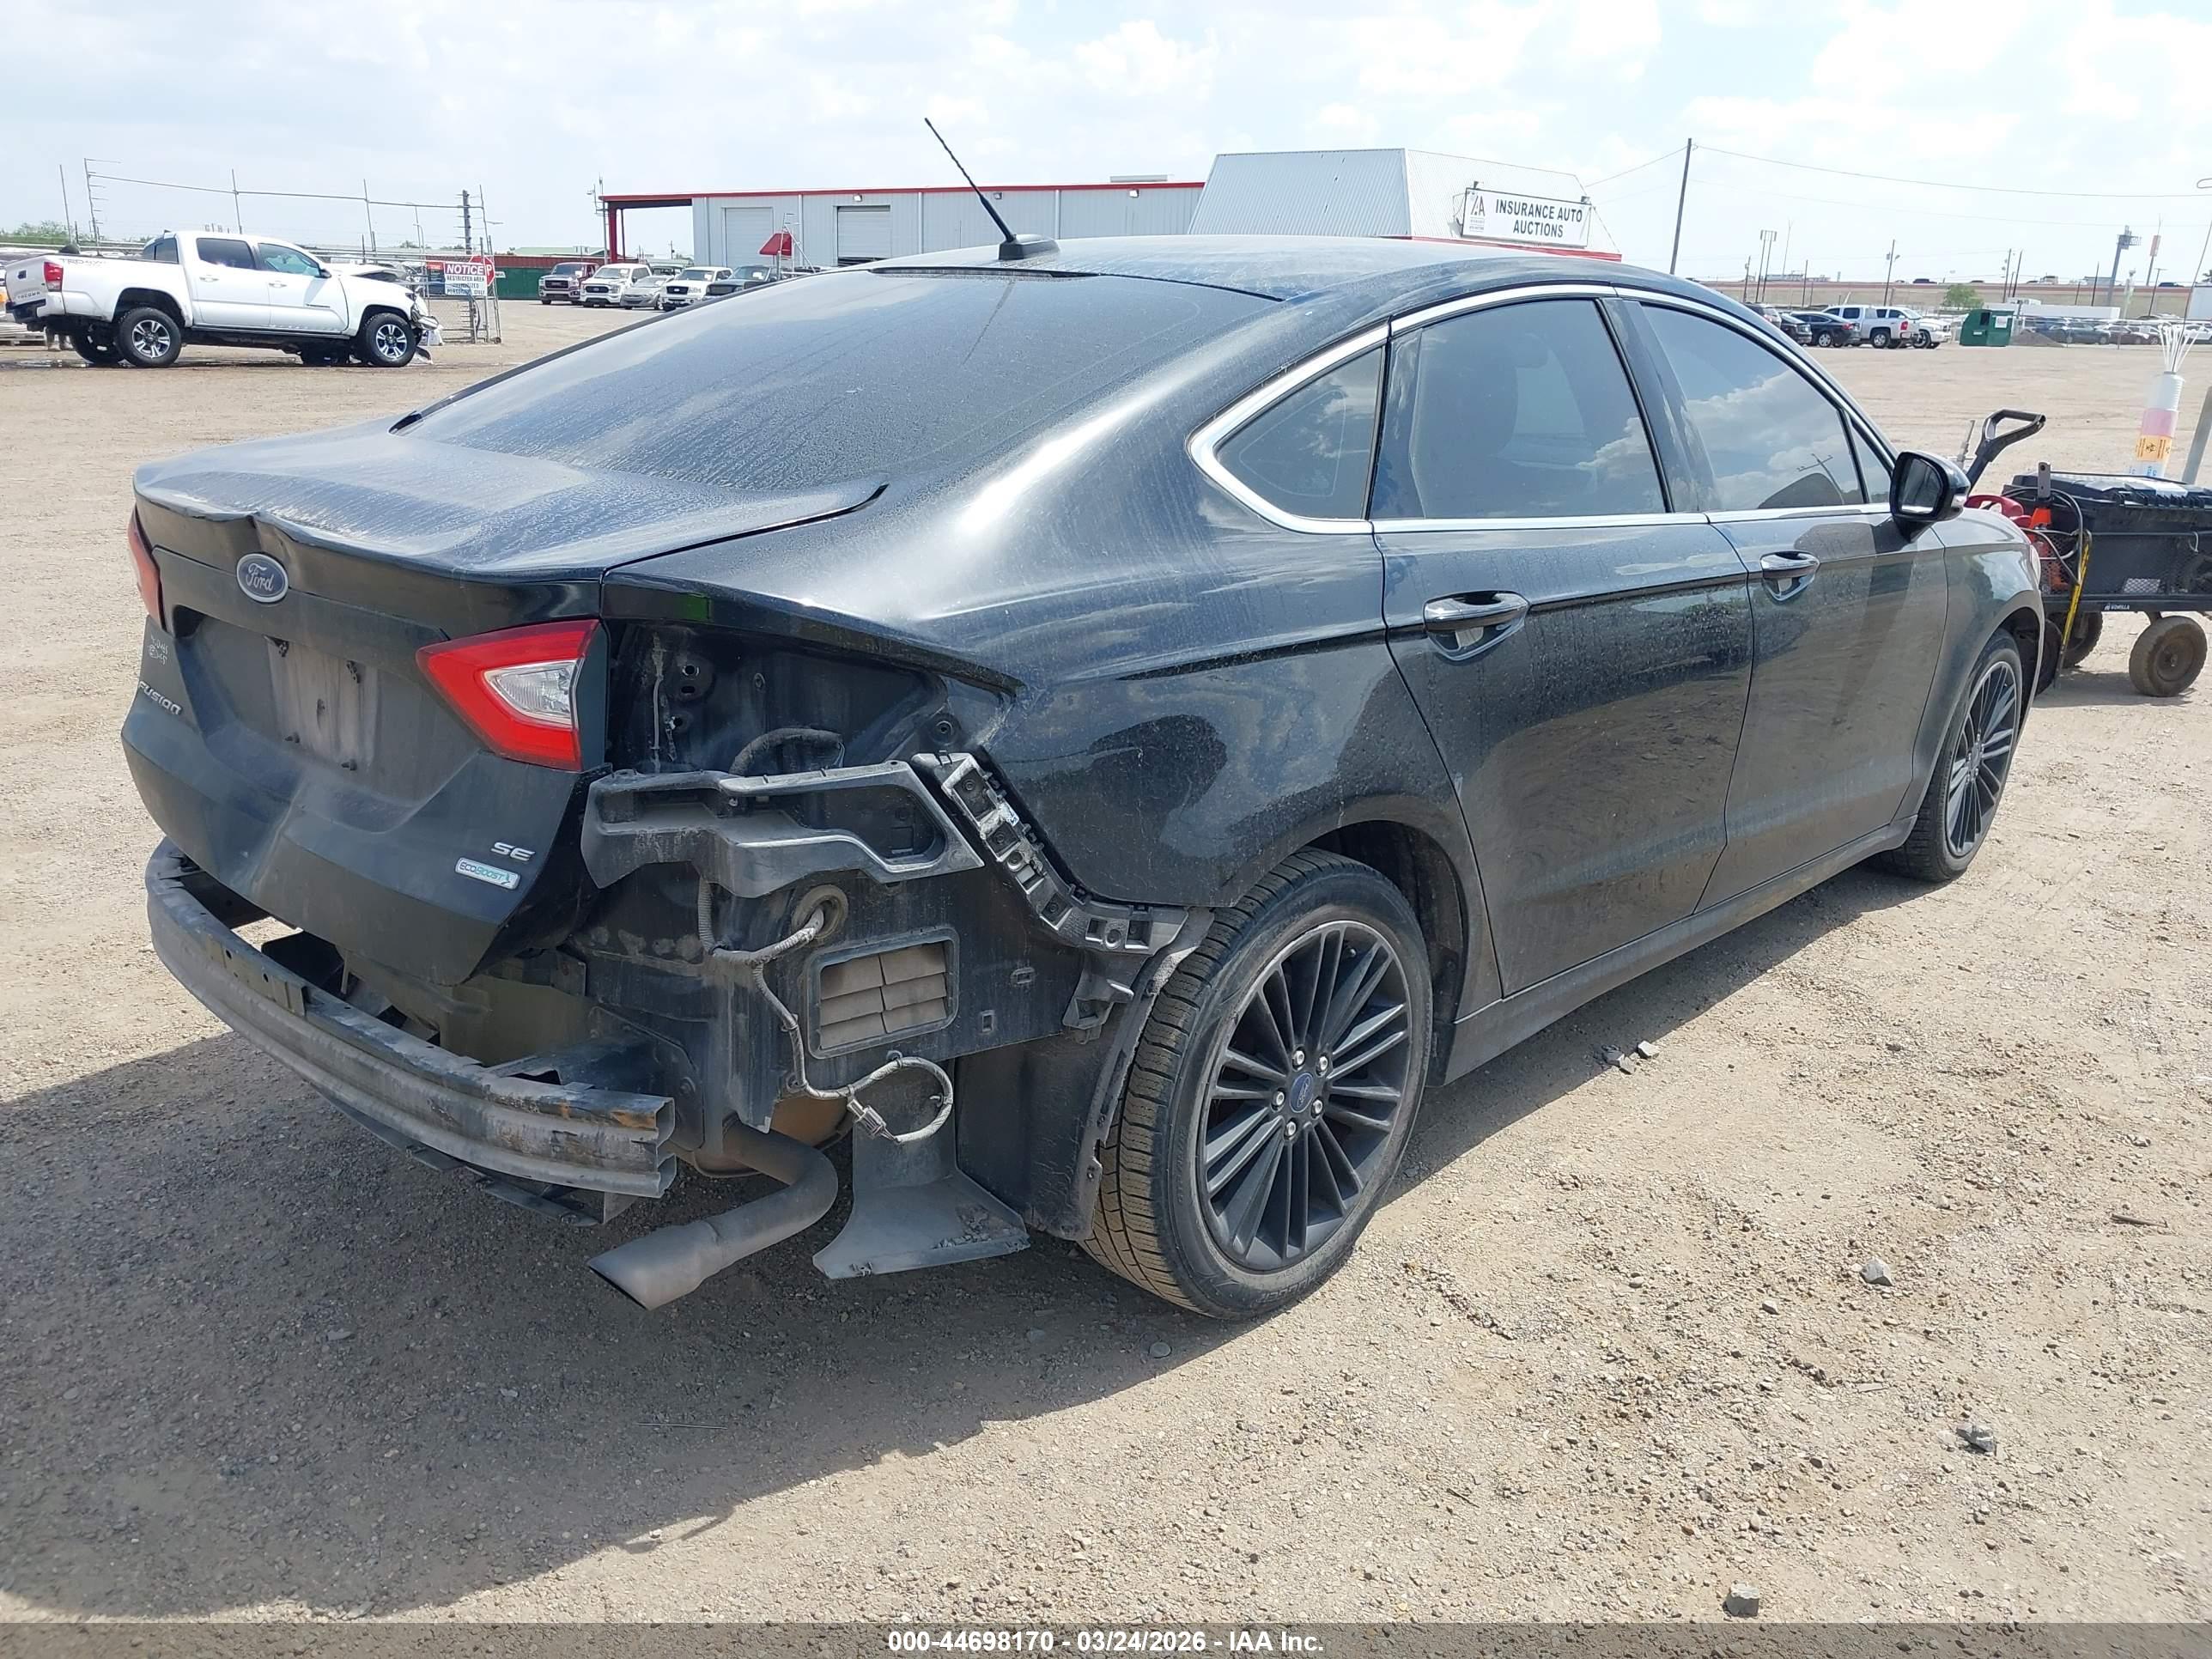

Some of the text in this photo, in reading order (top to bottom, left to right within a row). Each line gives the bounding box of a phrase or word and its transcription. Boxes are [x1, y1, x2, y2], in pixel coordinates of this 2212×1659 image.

[1495, 198, 1583, 223] INSURANCE AUTO
[1512, 219, 1564, 239] AUCTIONS
[447, 264, 484, 275] NOTICE
[246, 562, 275, 592] Ford
[138, 679, 183, 715] FUSION
[490, 842, 536, 861] SE
